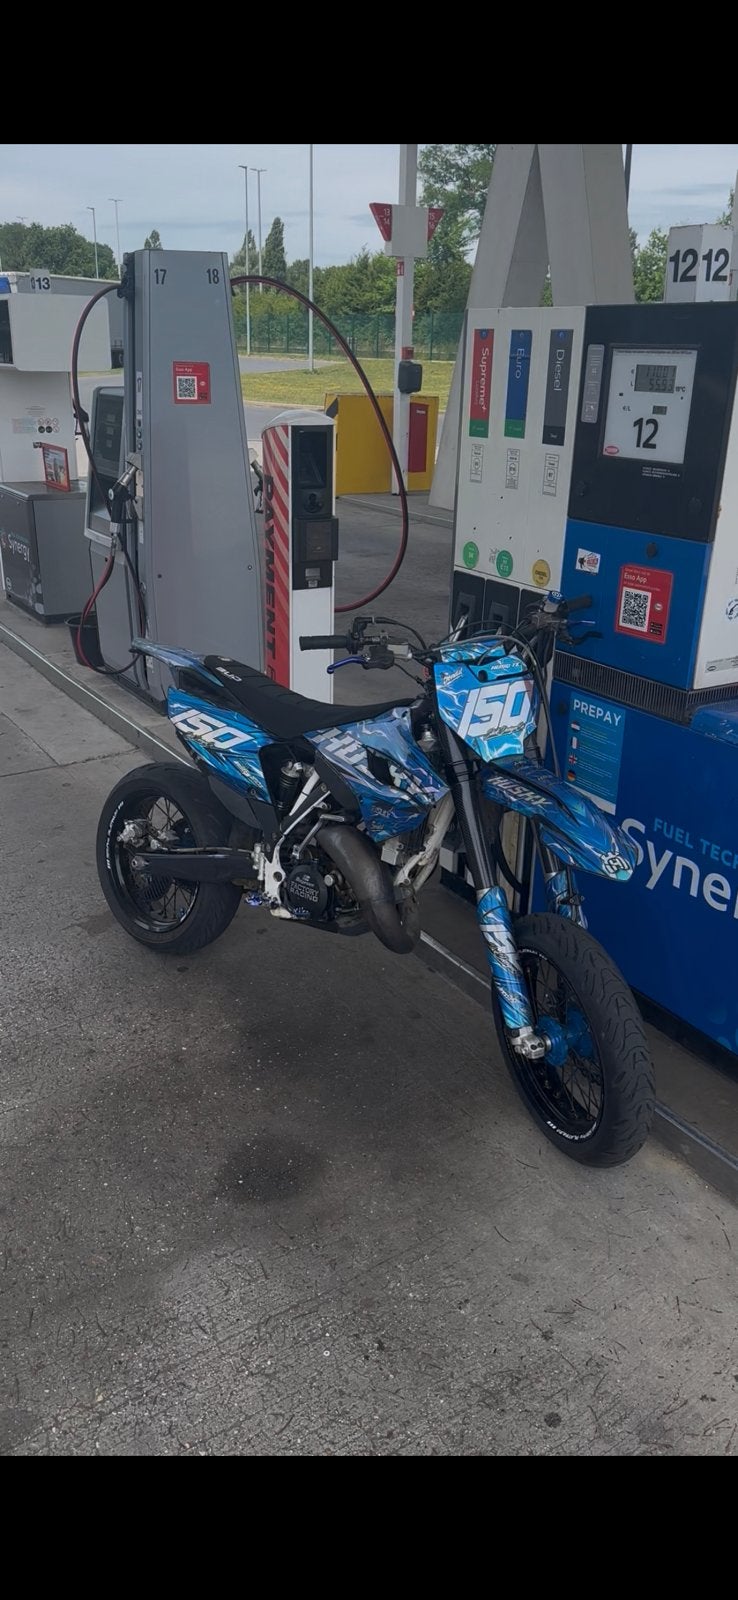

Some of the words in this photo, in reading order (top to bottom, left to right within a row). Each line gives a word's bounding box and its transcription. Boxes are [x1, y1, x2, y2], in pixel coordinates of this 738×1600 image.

[154, 268, 167, 285] 17
[206, 268, 220, 285] 18
[669, 248, 699, 283] 12
[702, 248, 730, 282] 12
[35, 277, 51, 290] 13
[515, 348, 525, 380] Euro
[553, 349, 566, 391] Diesel
[633, 417, 659, 449] 12
[264, 473, 276, 660] PAYMENT
[623, 572, 636, 581] Esso
[636, 574, 648, 585] App
[457, 679, 535, 741] 150
[573, 699, 622, 726] PREPAY
[170, 708, 256, 751] 150
[487, 776, 552, 806] HUSKY
[653, 817, 695, 849] FUEL
[290, 887, 319, 902] RACING
[291, 880, 319, 897] FACTORY
